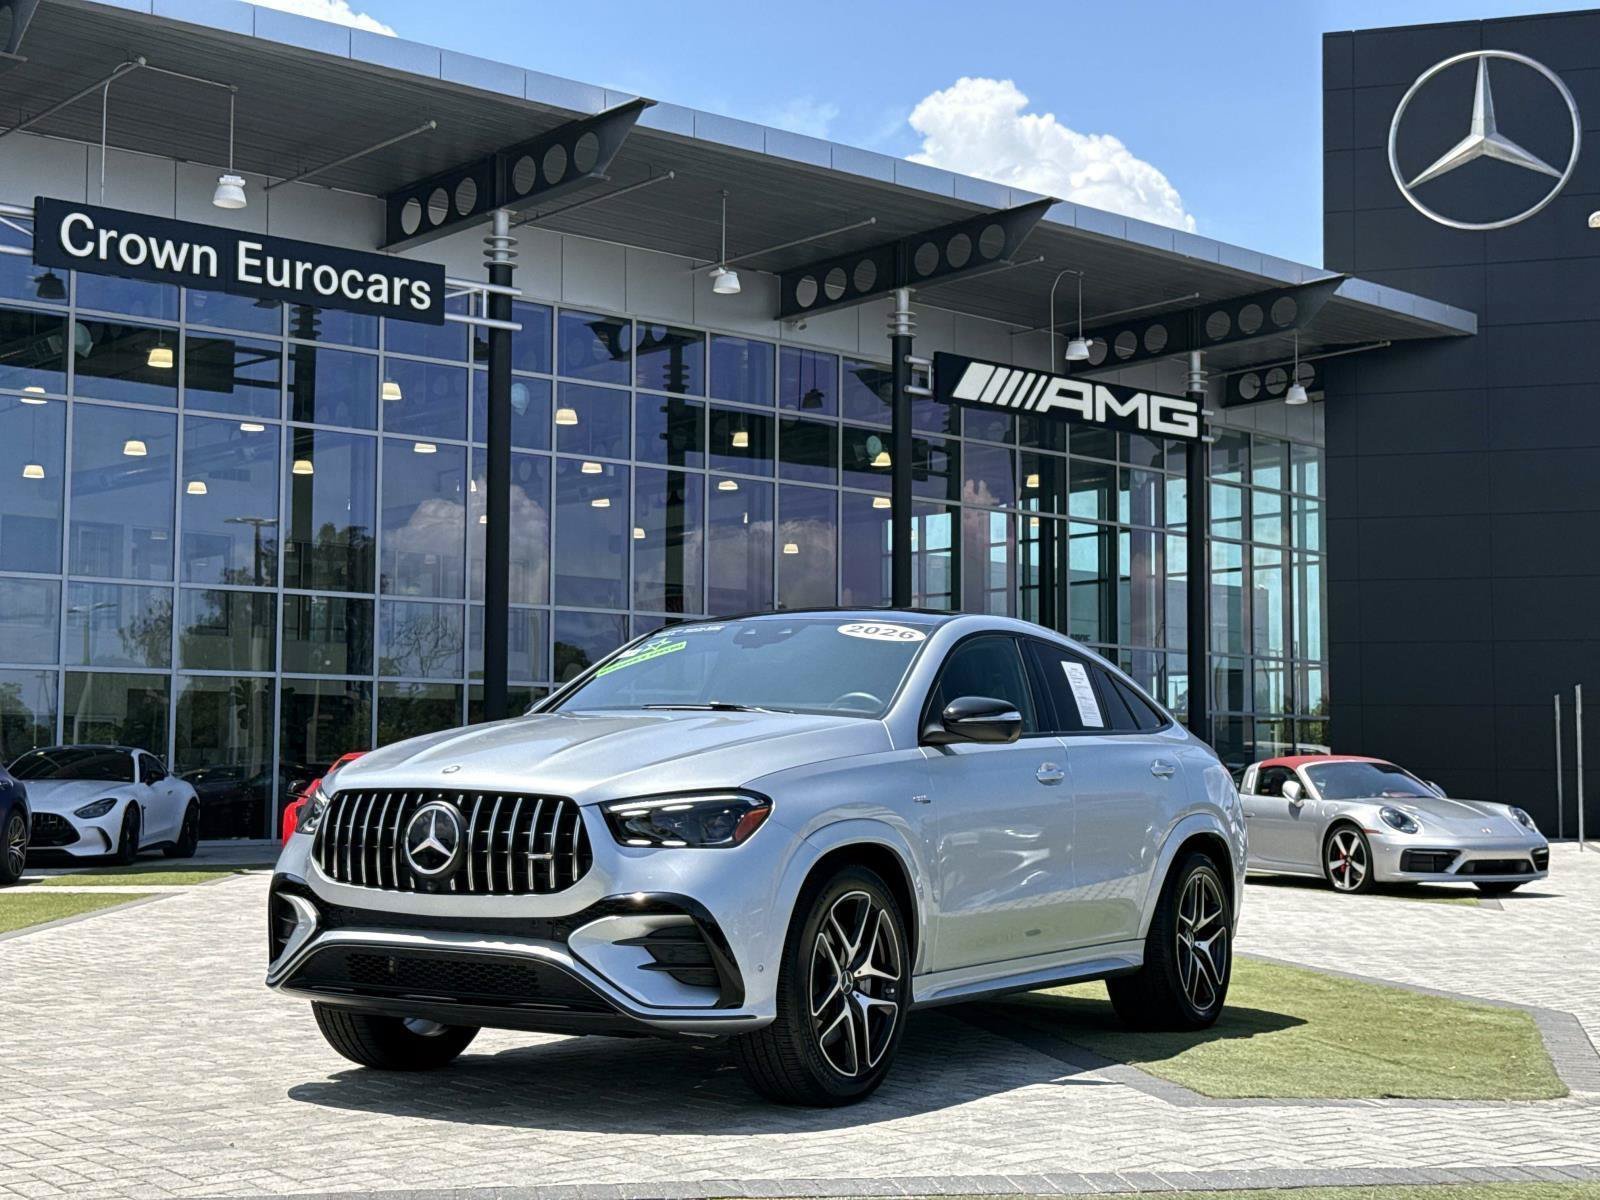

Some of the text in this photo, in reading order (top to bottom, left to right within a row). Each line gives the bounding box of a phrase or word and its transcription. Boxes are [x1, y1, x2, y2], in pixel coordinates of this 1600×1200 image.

[60, 212, 431, 310] Crown Eurocars
[1034, 377, 1198, 438] AMG
[846, 625, 916, 639] 2026
